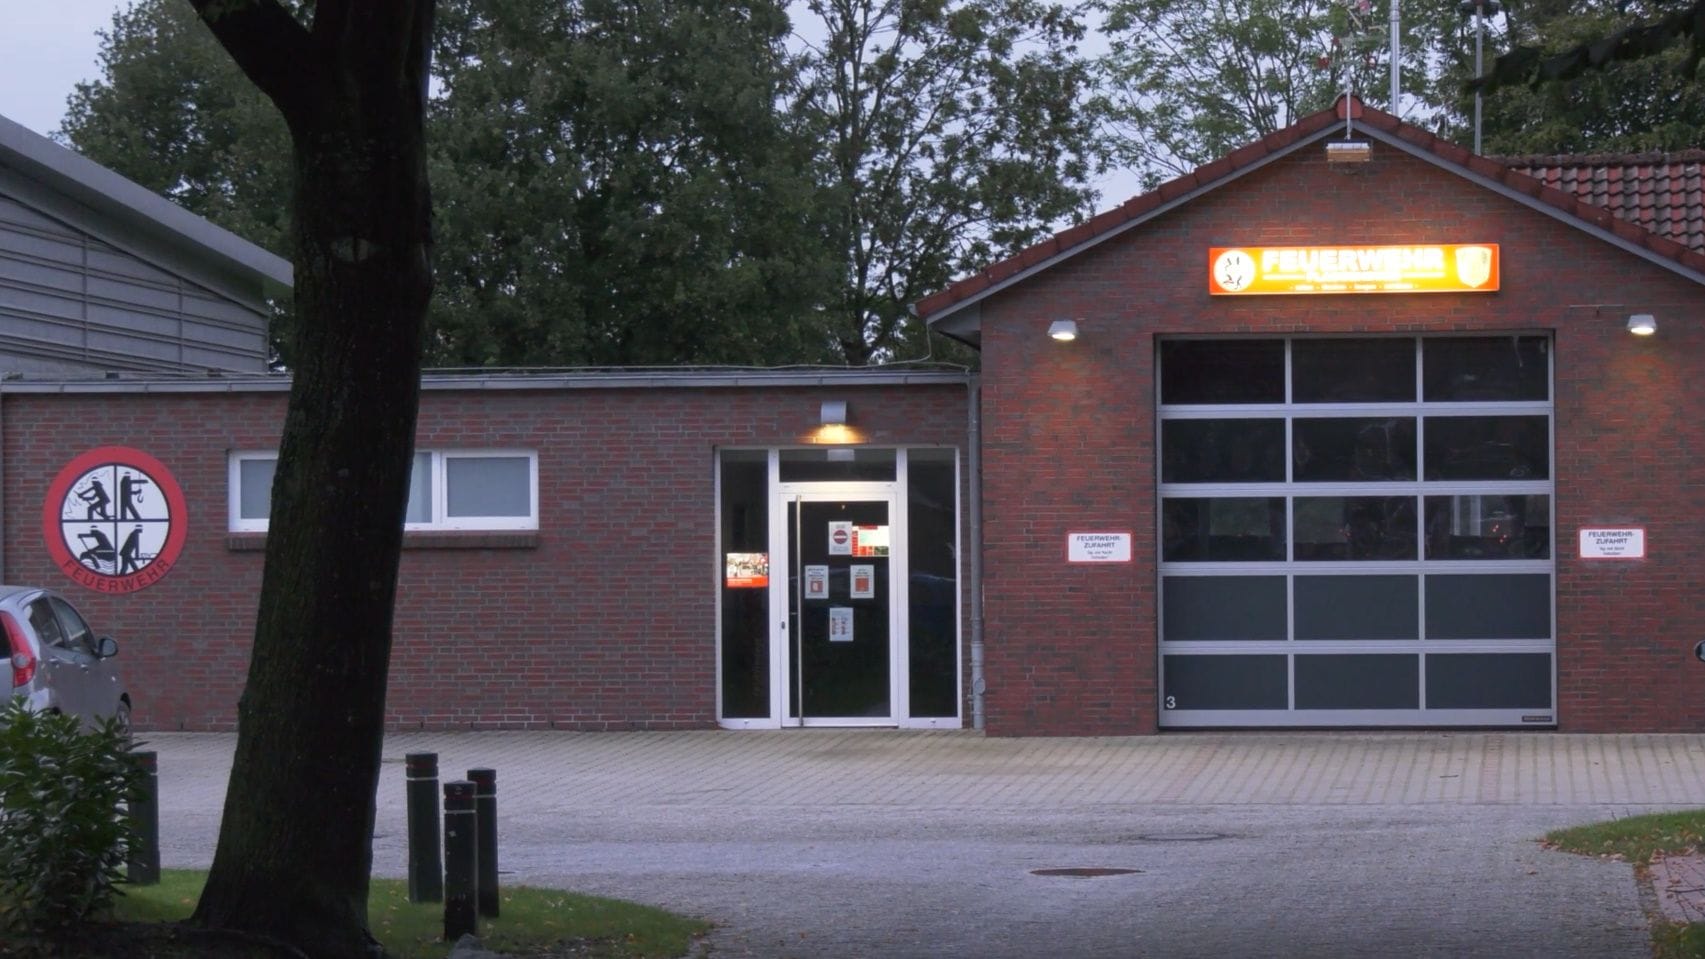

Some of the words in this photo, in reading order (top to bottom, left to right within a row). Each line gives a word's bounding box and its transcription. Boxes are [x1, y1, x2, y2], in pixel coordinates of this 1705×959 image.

[1262, 248, 1444, 272] FEUERWEHR
[62, 558, 169, 592] FEUERWEHR
[1166, 695, 1176, 709] 3
